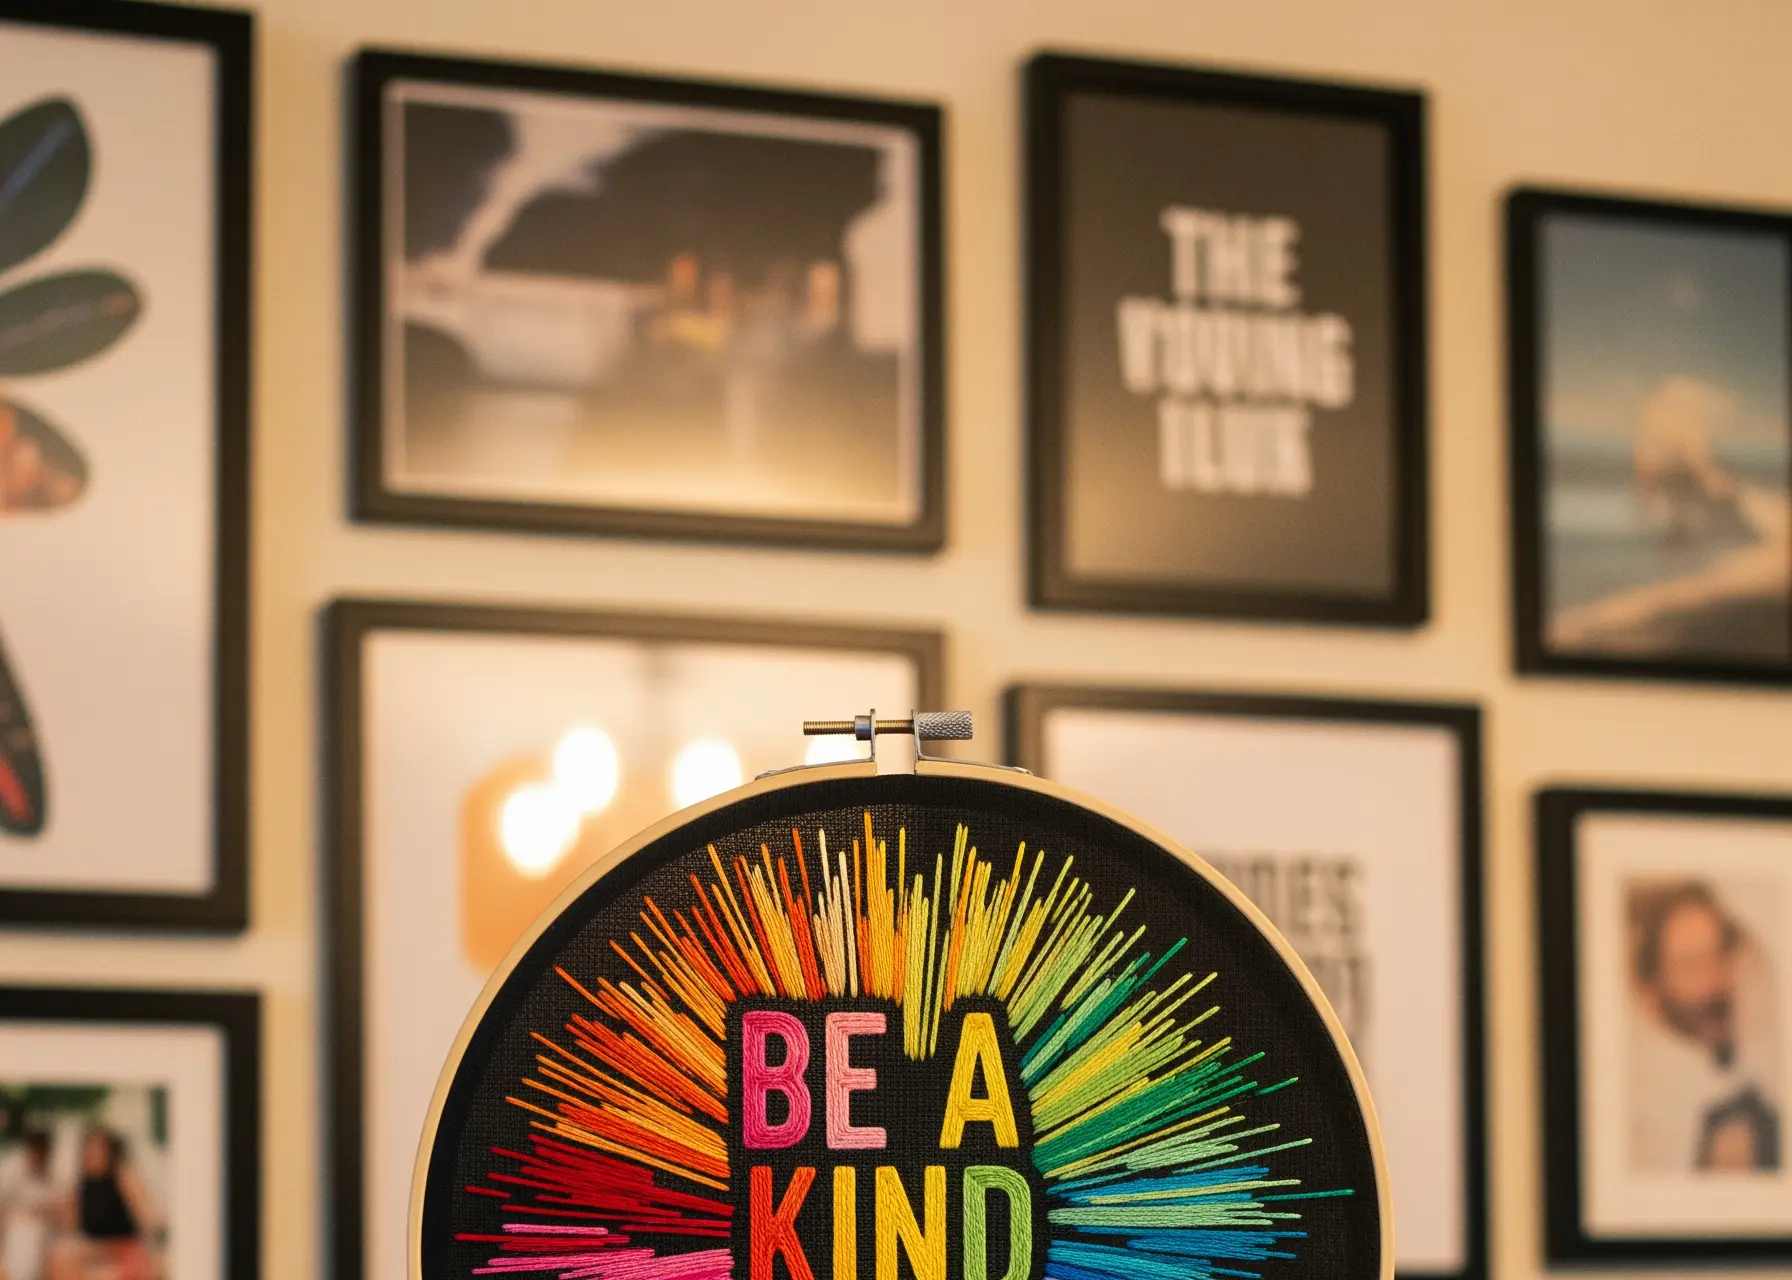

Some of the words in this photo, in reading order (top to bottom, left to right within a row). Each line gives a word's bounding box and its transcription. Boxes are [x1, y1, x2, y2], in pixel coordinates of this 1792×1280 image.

[1159, 206, 1301, 305] THE
[742, 1010, 887, 1149] BE
[939, 1012, 1019, 1149] A
